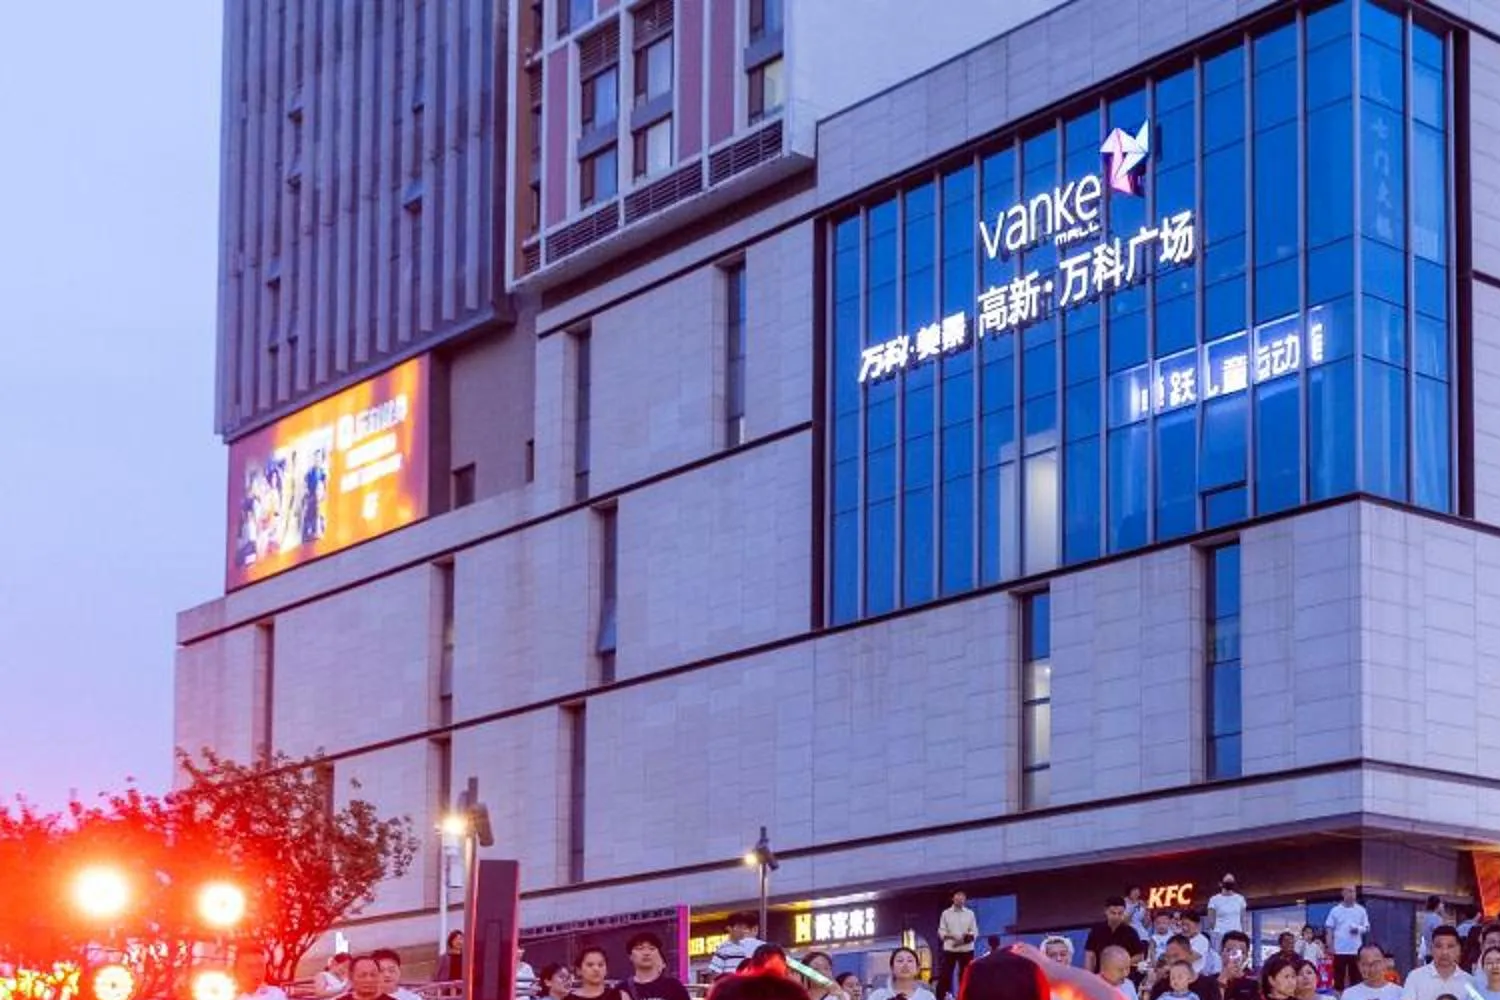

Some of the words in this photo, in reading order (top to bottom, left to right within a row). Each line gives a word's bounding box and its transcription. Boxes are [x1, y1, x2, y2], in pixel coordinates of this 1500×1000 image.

[979, 174, 1101, 260] vanke
[1055, 222, 1101, 246] MALL
[977, 210, 1195, 339] 高新·万科广场
[1147, 883, 1193, 909] KFC
